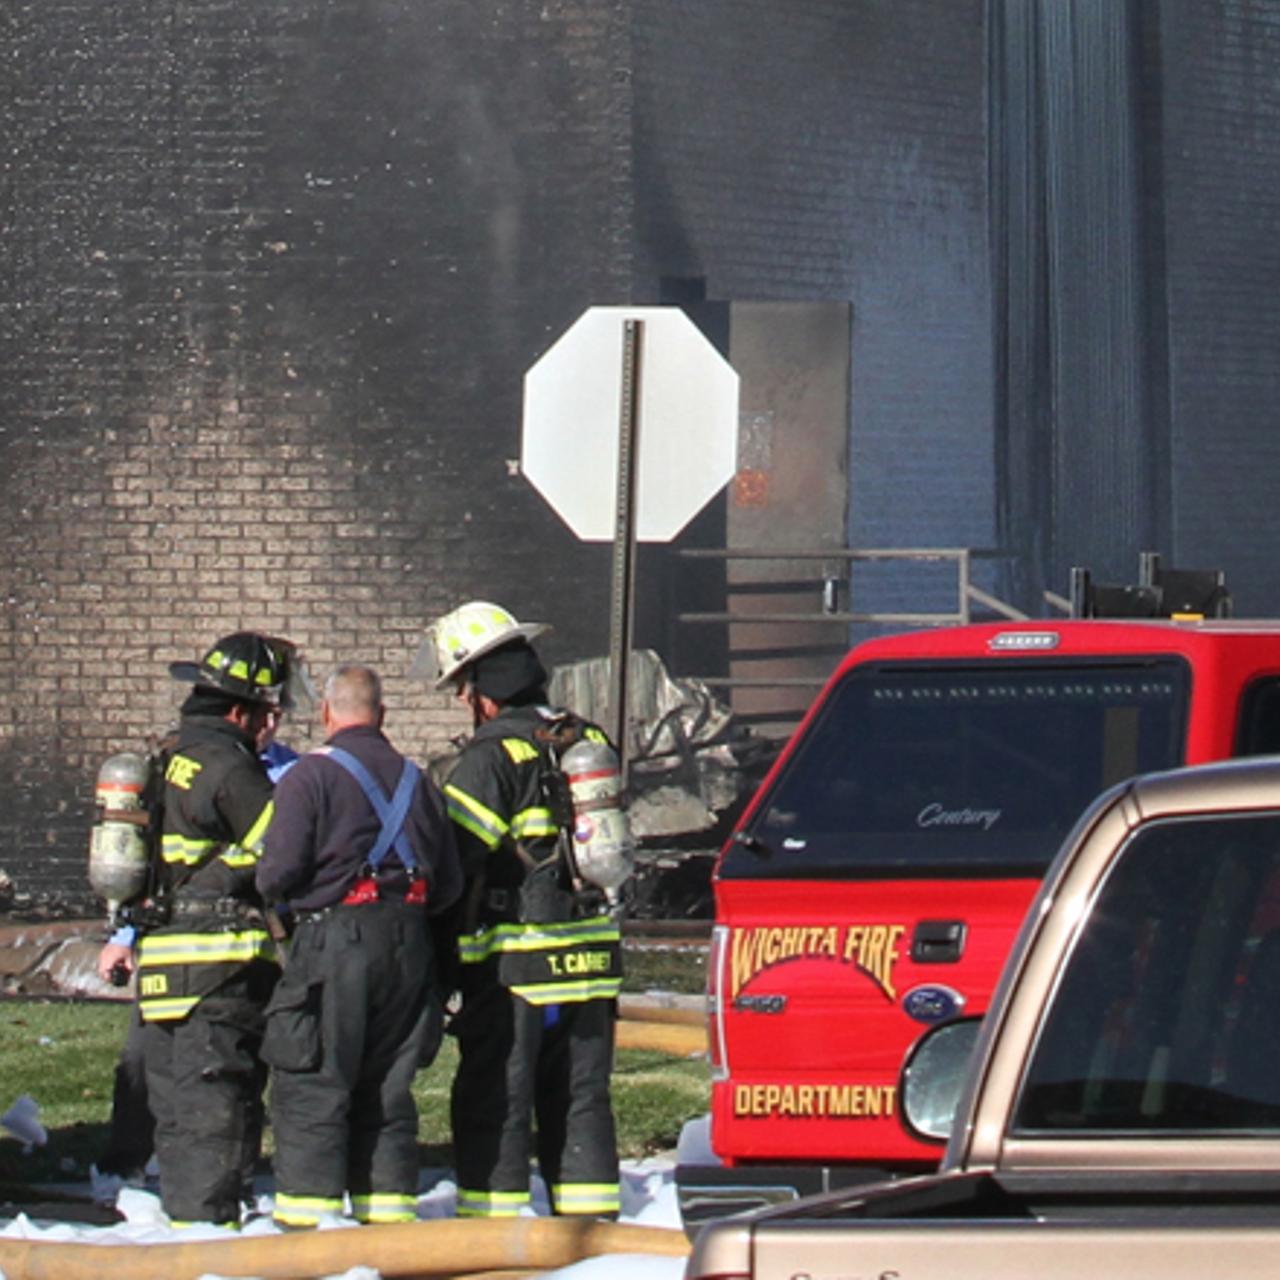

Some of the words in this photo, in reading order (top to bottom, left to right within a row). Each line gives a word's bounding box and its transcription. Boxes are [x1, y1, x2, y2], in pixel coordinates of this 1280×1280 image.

[916, 802, 1002, 831] Century
[731, 926, 837, 1001] WICHITA
[843, 925, 905, 1003] FIRE
[735, 1084, 896, 1116] DEPARTMENT
